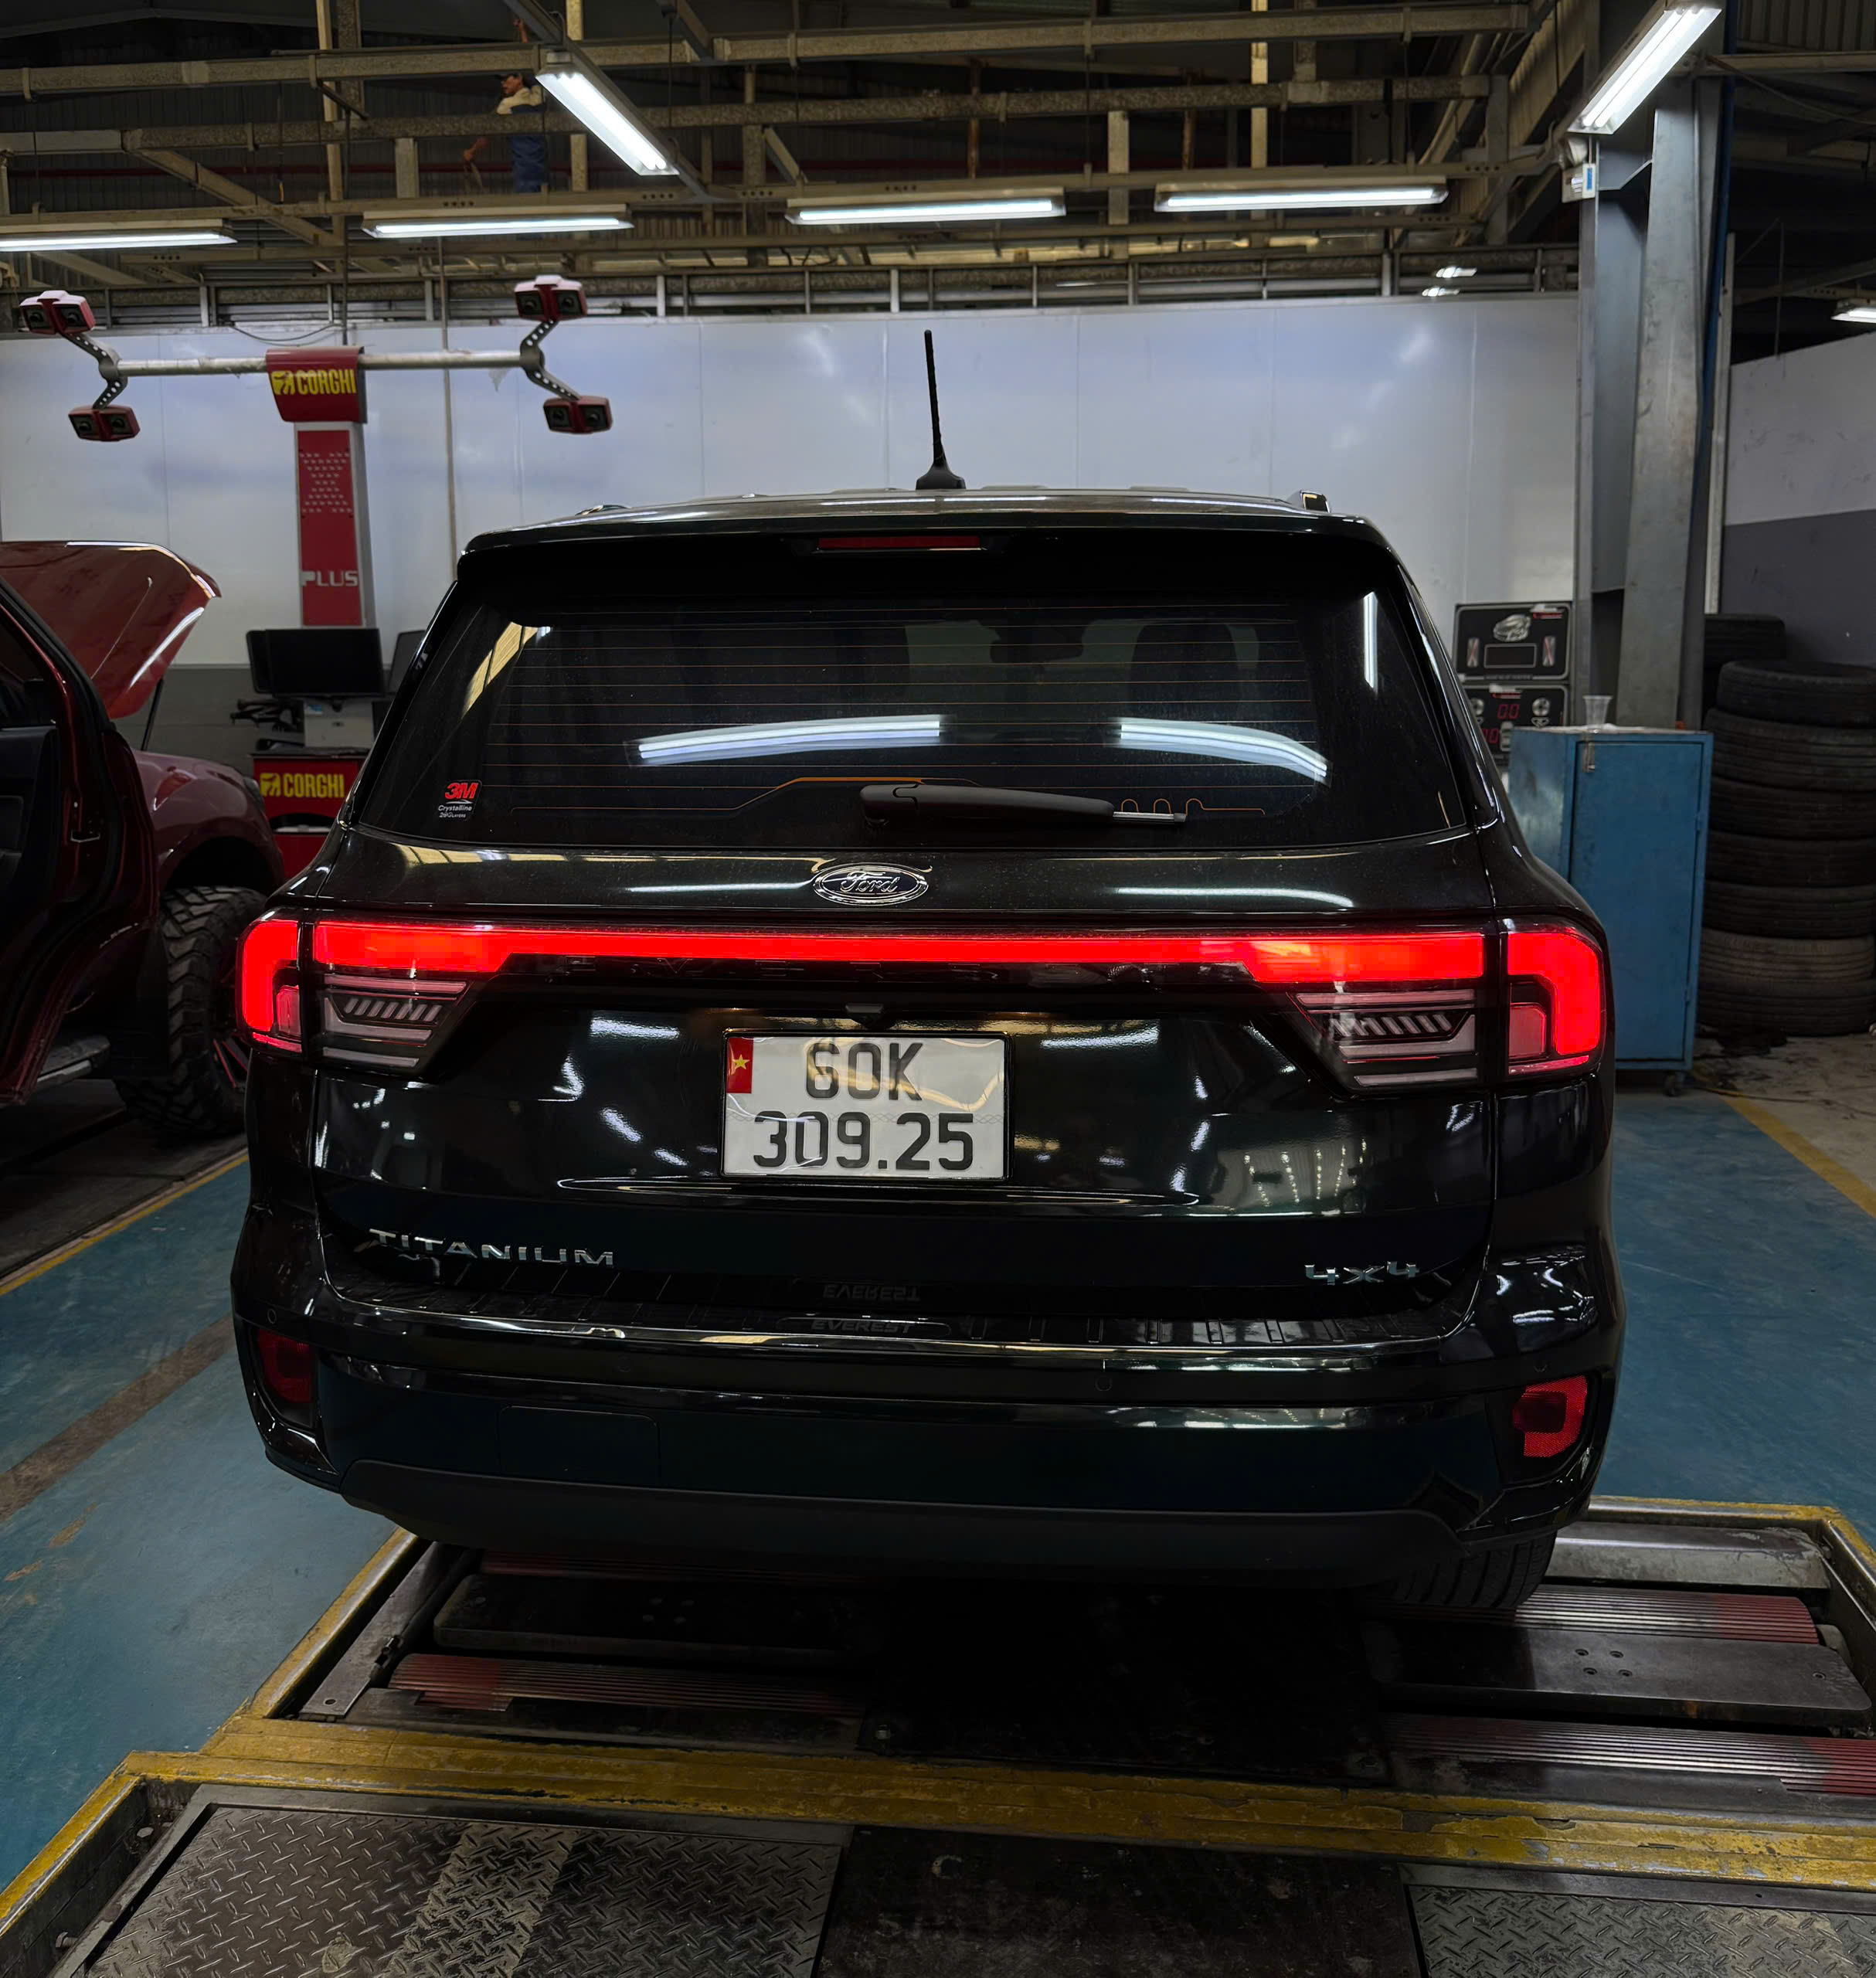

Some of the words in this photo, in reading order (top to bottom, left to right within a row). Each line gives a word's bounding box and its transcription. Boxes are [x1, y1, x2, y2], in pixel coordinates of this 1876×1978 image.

[297, 369, 356, 395] CORGHI
[299, 569, 359, 586] PLUS
[283, 773, 345, 797] CORGHI
[445, 783, 478, 799] 3M
[840, 871, 900, 892] Ford
[806, 1042, 923, 1100] 60K
[753, 1110, 974, 1170] 309.25
[369, 1228, 613, 1266] TITANIUM
[811, 1320, 915, 1334] EVEREST
